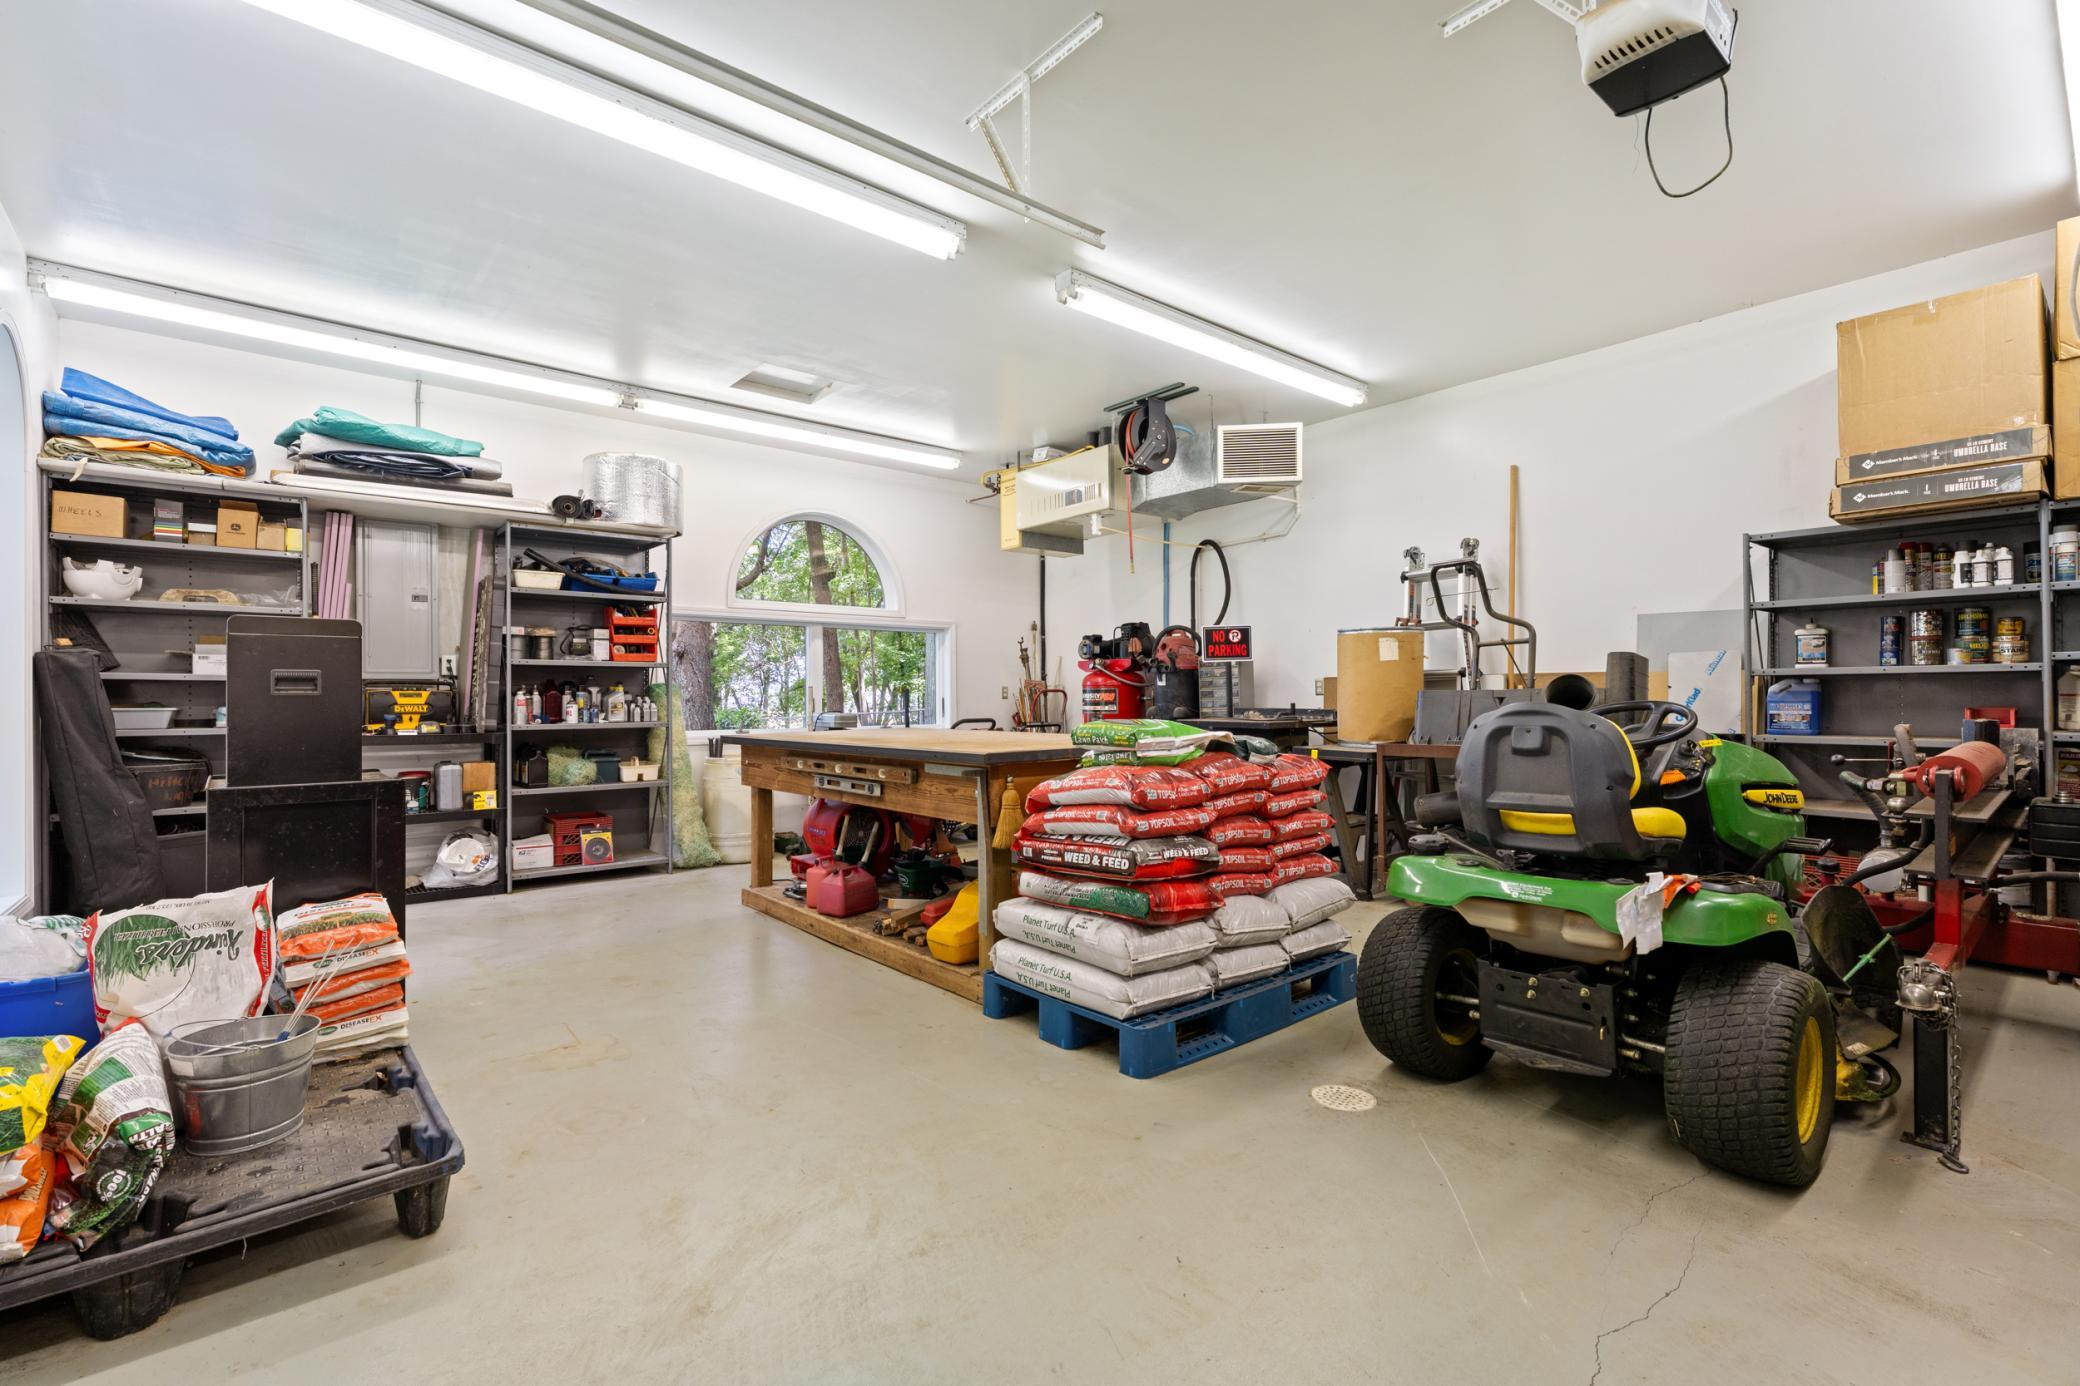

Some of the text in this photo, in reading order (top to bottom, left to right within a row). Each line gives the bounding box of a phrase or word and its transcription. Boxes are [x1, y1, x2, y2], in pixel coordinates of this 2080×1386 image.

[1953, 444, 1989, 457] UMBRELLA
[1990, 441, 2008, 452] BASE
[1944, 480, 1980, 492] UMBRELLA
[1981, 478, 1998, 489] BASE
[1211, 629, 1226, 643] NO
[1207, 644, 1248, 657] PARKING
[1074, 735, 1091, 744] Lawn
[1763, 791, 1799, 805] JOHN DEERE
[1149, 817, 1176, 829] TOPSOIL
[1162, 849, 1183, 859] WEED
[1189, 846, 1209, 857] FEED
[1063, 852, 1130, 870] WEED & FEED
[1022, 914, 1077, 938] Planet Turf U.S.A.
[135, 928, 244, 969] Reinders
[1040, 936, 1056, 947] Turf
[1055, 940, 1077, 954] Planet
[1018, 956, 1073, 981] Planet Turf U.S.A.
[1034, 978, 1048, 992] Turf
[1049, 985, 1071, 999] Planet
[101, 1168, 128, 1203] 100%
